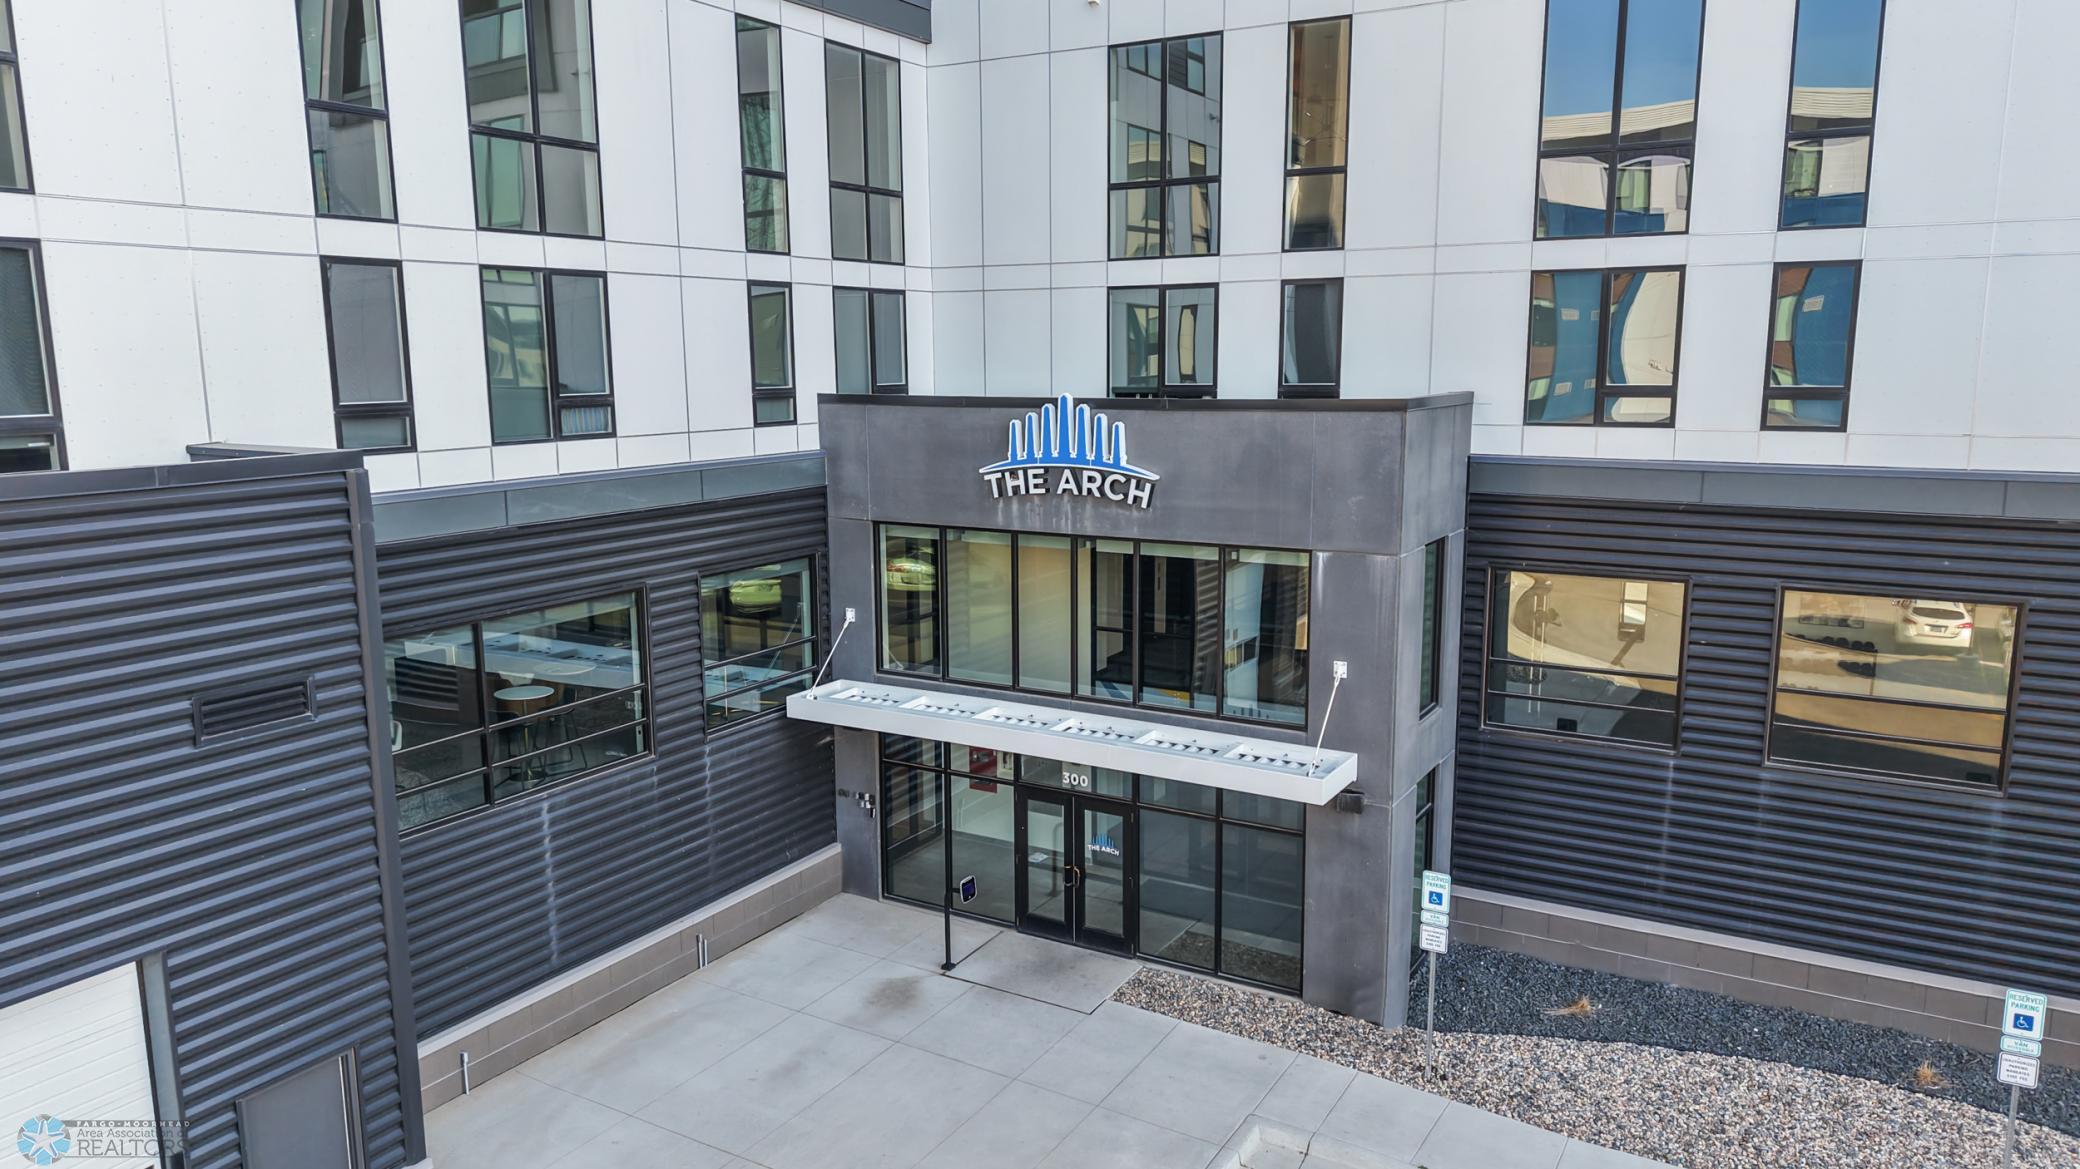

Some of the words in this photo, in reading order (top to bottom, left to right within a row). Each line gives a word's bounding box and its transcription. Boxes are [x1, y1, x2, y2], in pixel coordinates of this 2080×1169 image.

[984, 468, 1047, 499] THE
[1056, 468, 1152, 509] ARCH
[1062, 772, 1089, 787] 300
[1087, 844, 1100, 852] THE
[1101, 845, 1120, 857] ARCH
[2008, 992, 2044, 1006] RESERVED
[2010, 1000, 2040, 1012] PARKING
